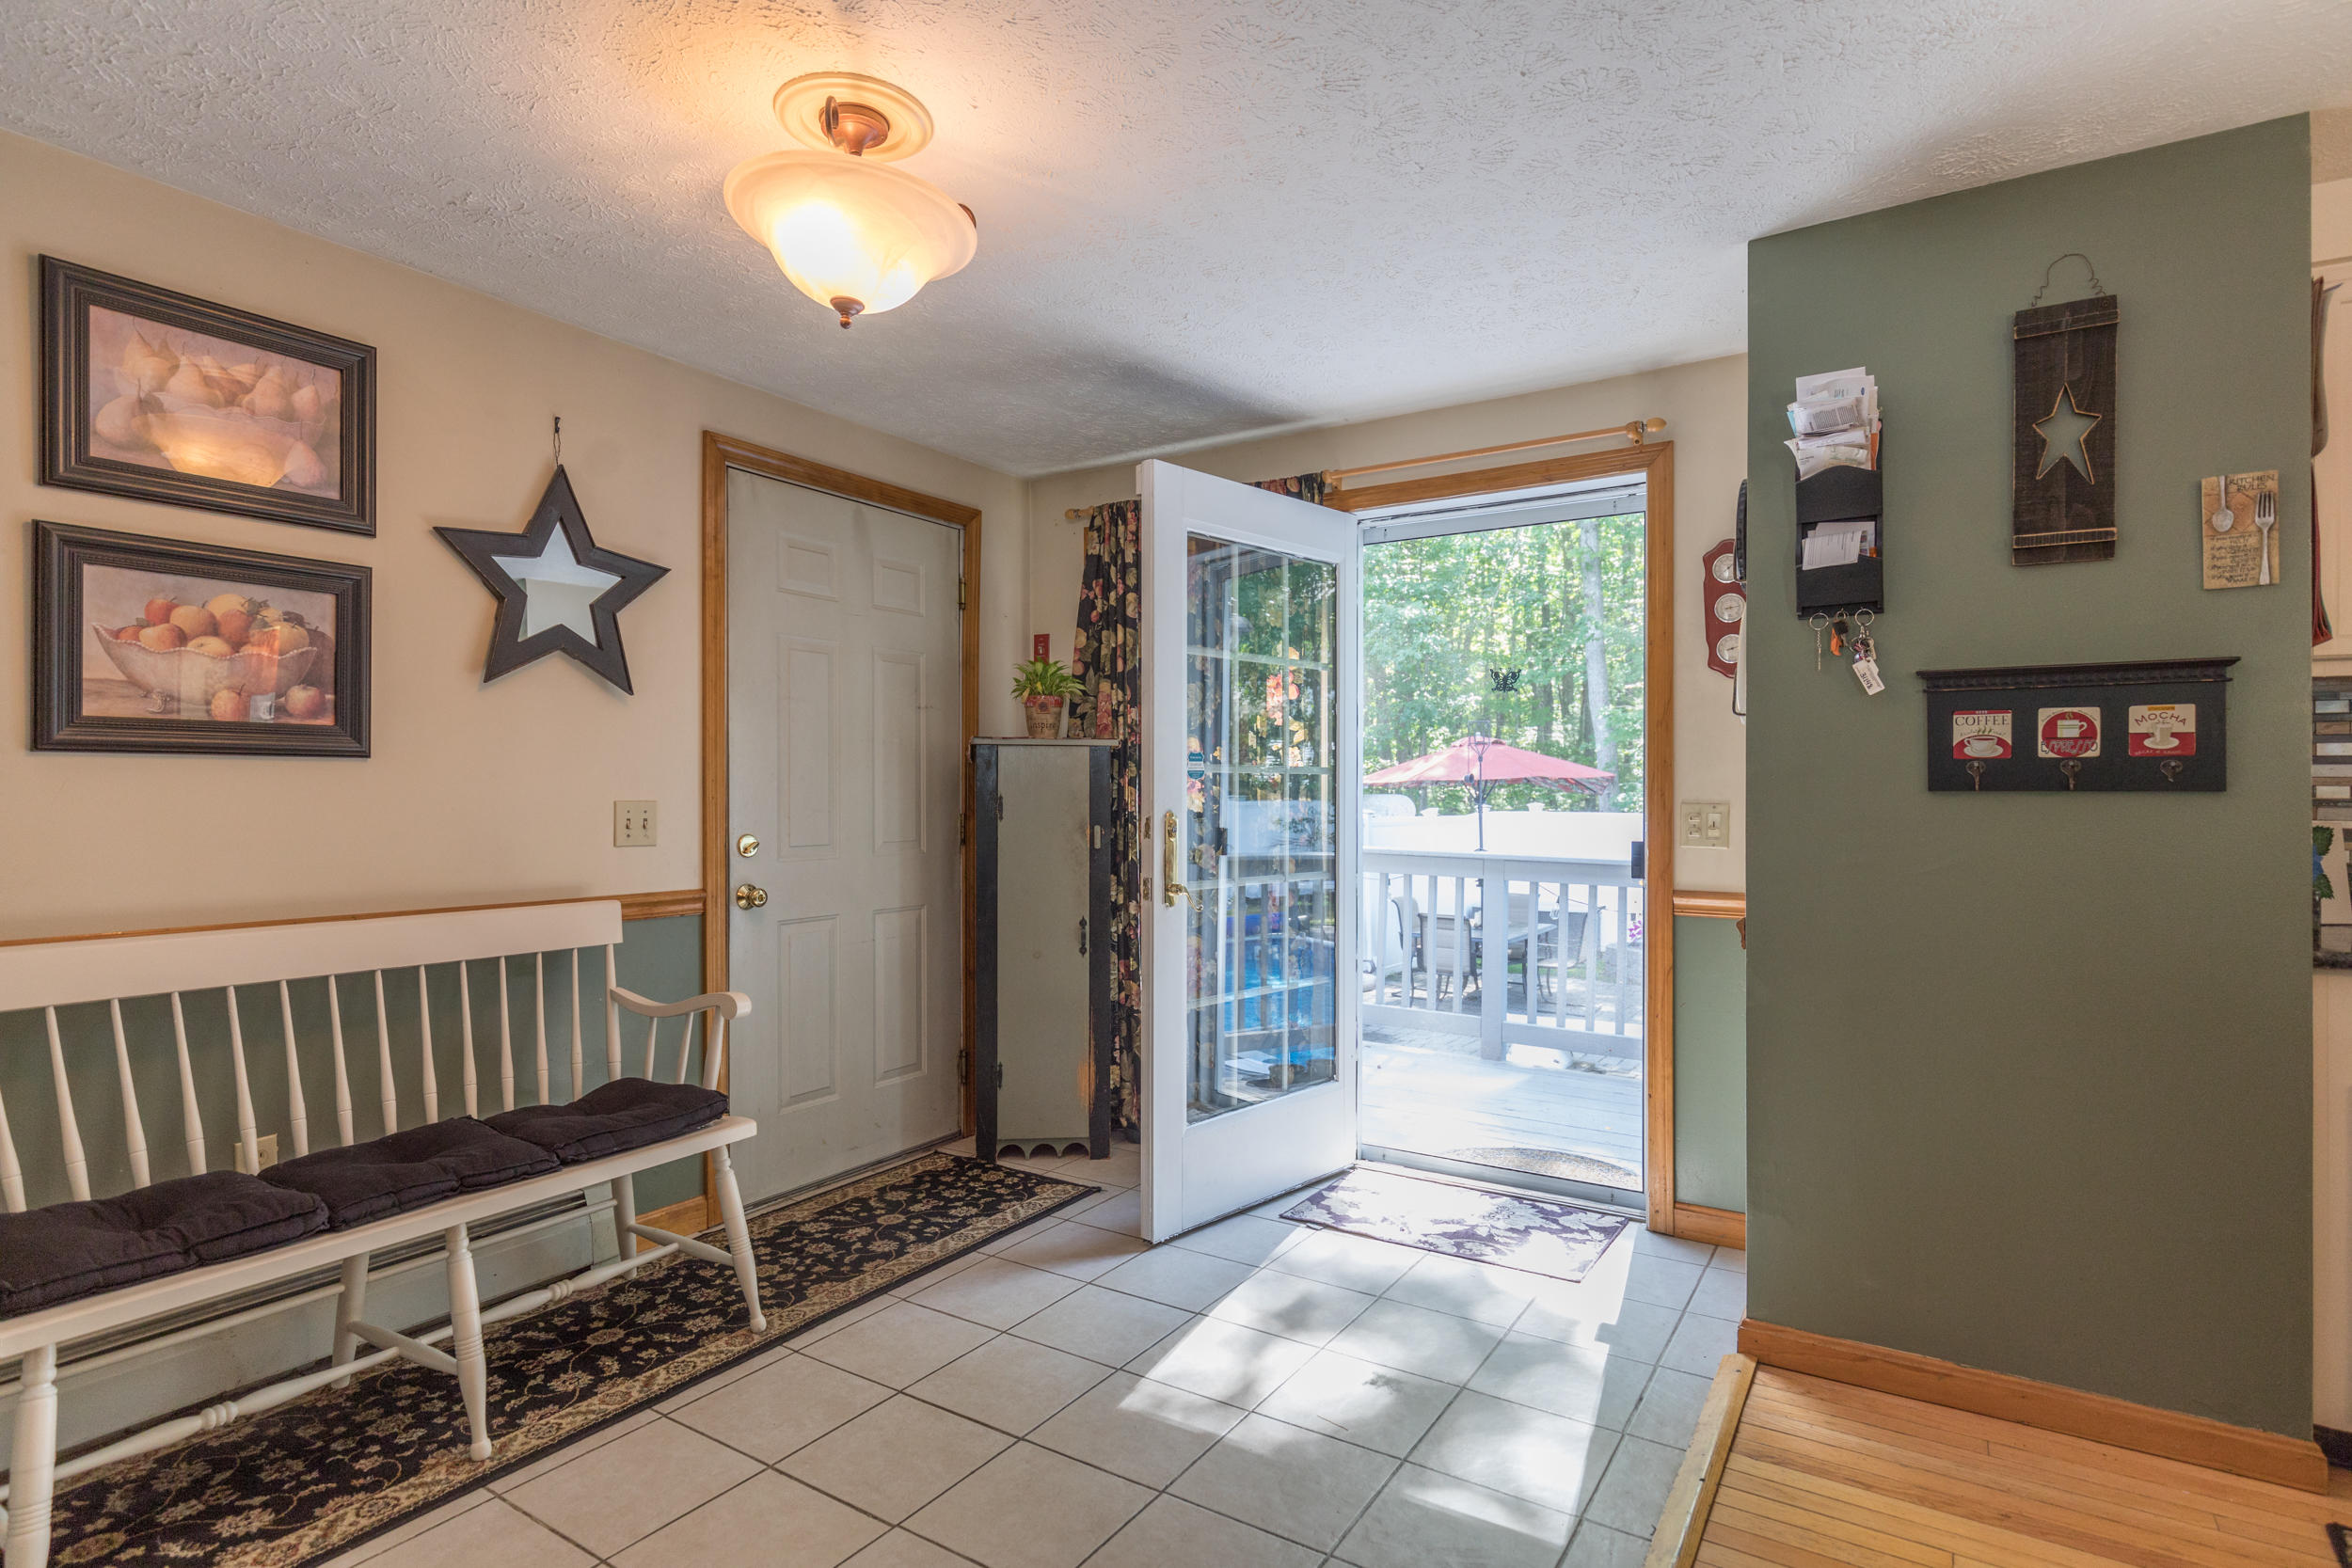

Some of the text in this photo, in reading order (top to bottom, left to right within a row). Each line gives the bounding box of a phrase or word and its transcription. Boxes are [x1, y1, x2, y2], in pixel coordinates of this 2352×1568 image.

[2228, 474, 2275, 485] KITCHEN
[2237, 482, 2266, 492] RULES
[1955, 715, 2010, 726] COFFEE
[2134, 711, 2187, 726] MOCHA
